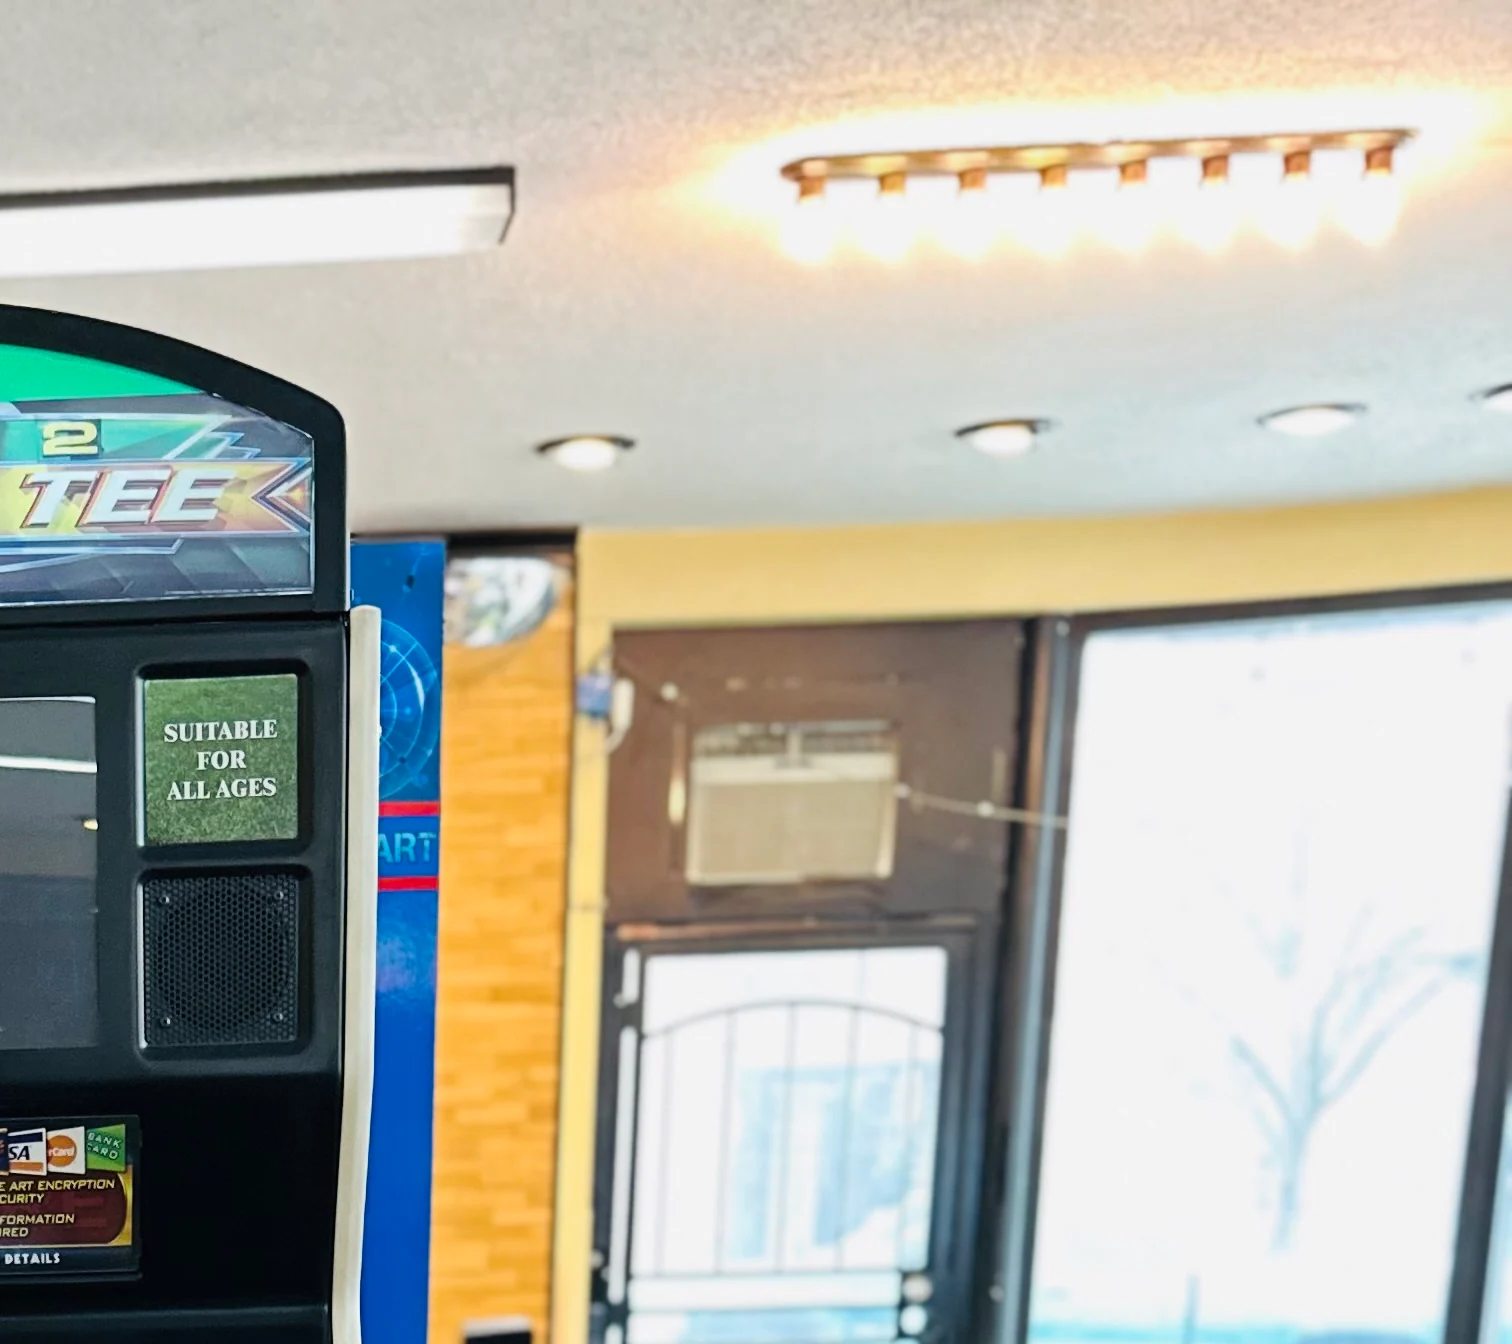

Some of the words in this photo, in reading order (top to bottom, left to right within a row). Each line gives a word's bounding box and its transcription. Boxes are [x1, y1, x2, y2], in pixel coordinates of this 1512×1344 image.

[22, 468, 232, 527] TEE
[164, 719, 278, 743] SUITABLE
[196, 750, 247, 770] FOR
[167, 781, 210, 801] ALL
[216, 778, 276, 798] AGES
[89, 1132, 122, 1148] BANK
[9, 1180, 34, 1191] ART
[38, 1179, 115, 1190] ENCRYPTION
[5, 1253, 60, 1265] DETAILS
